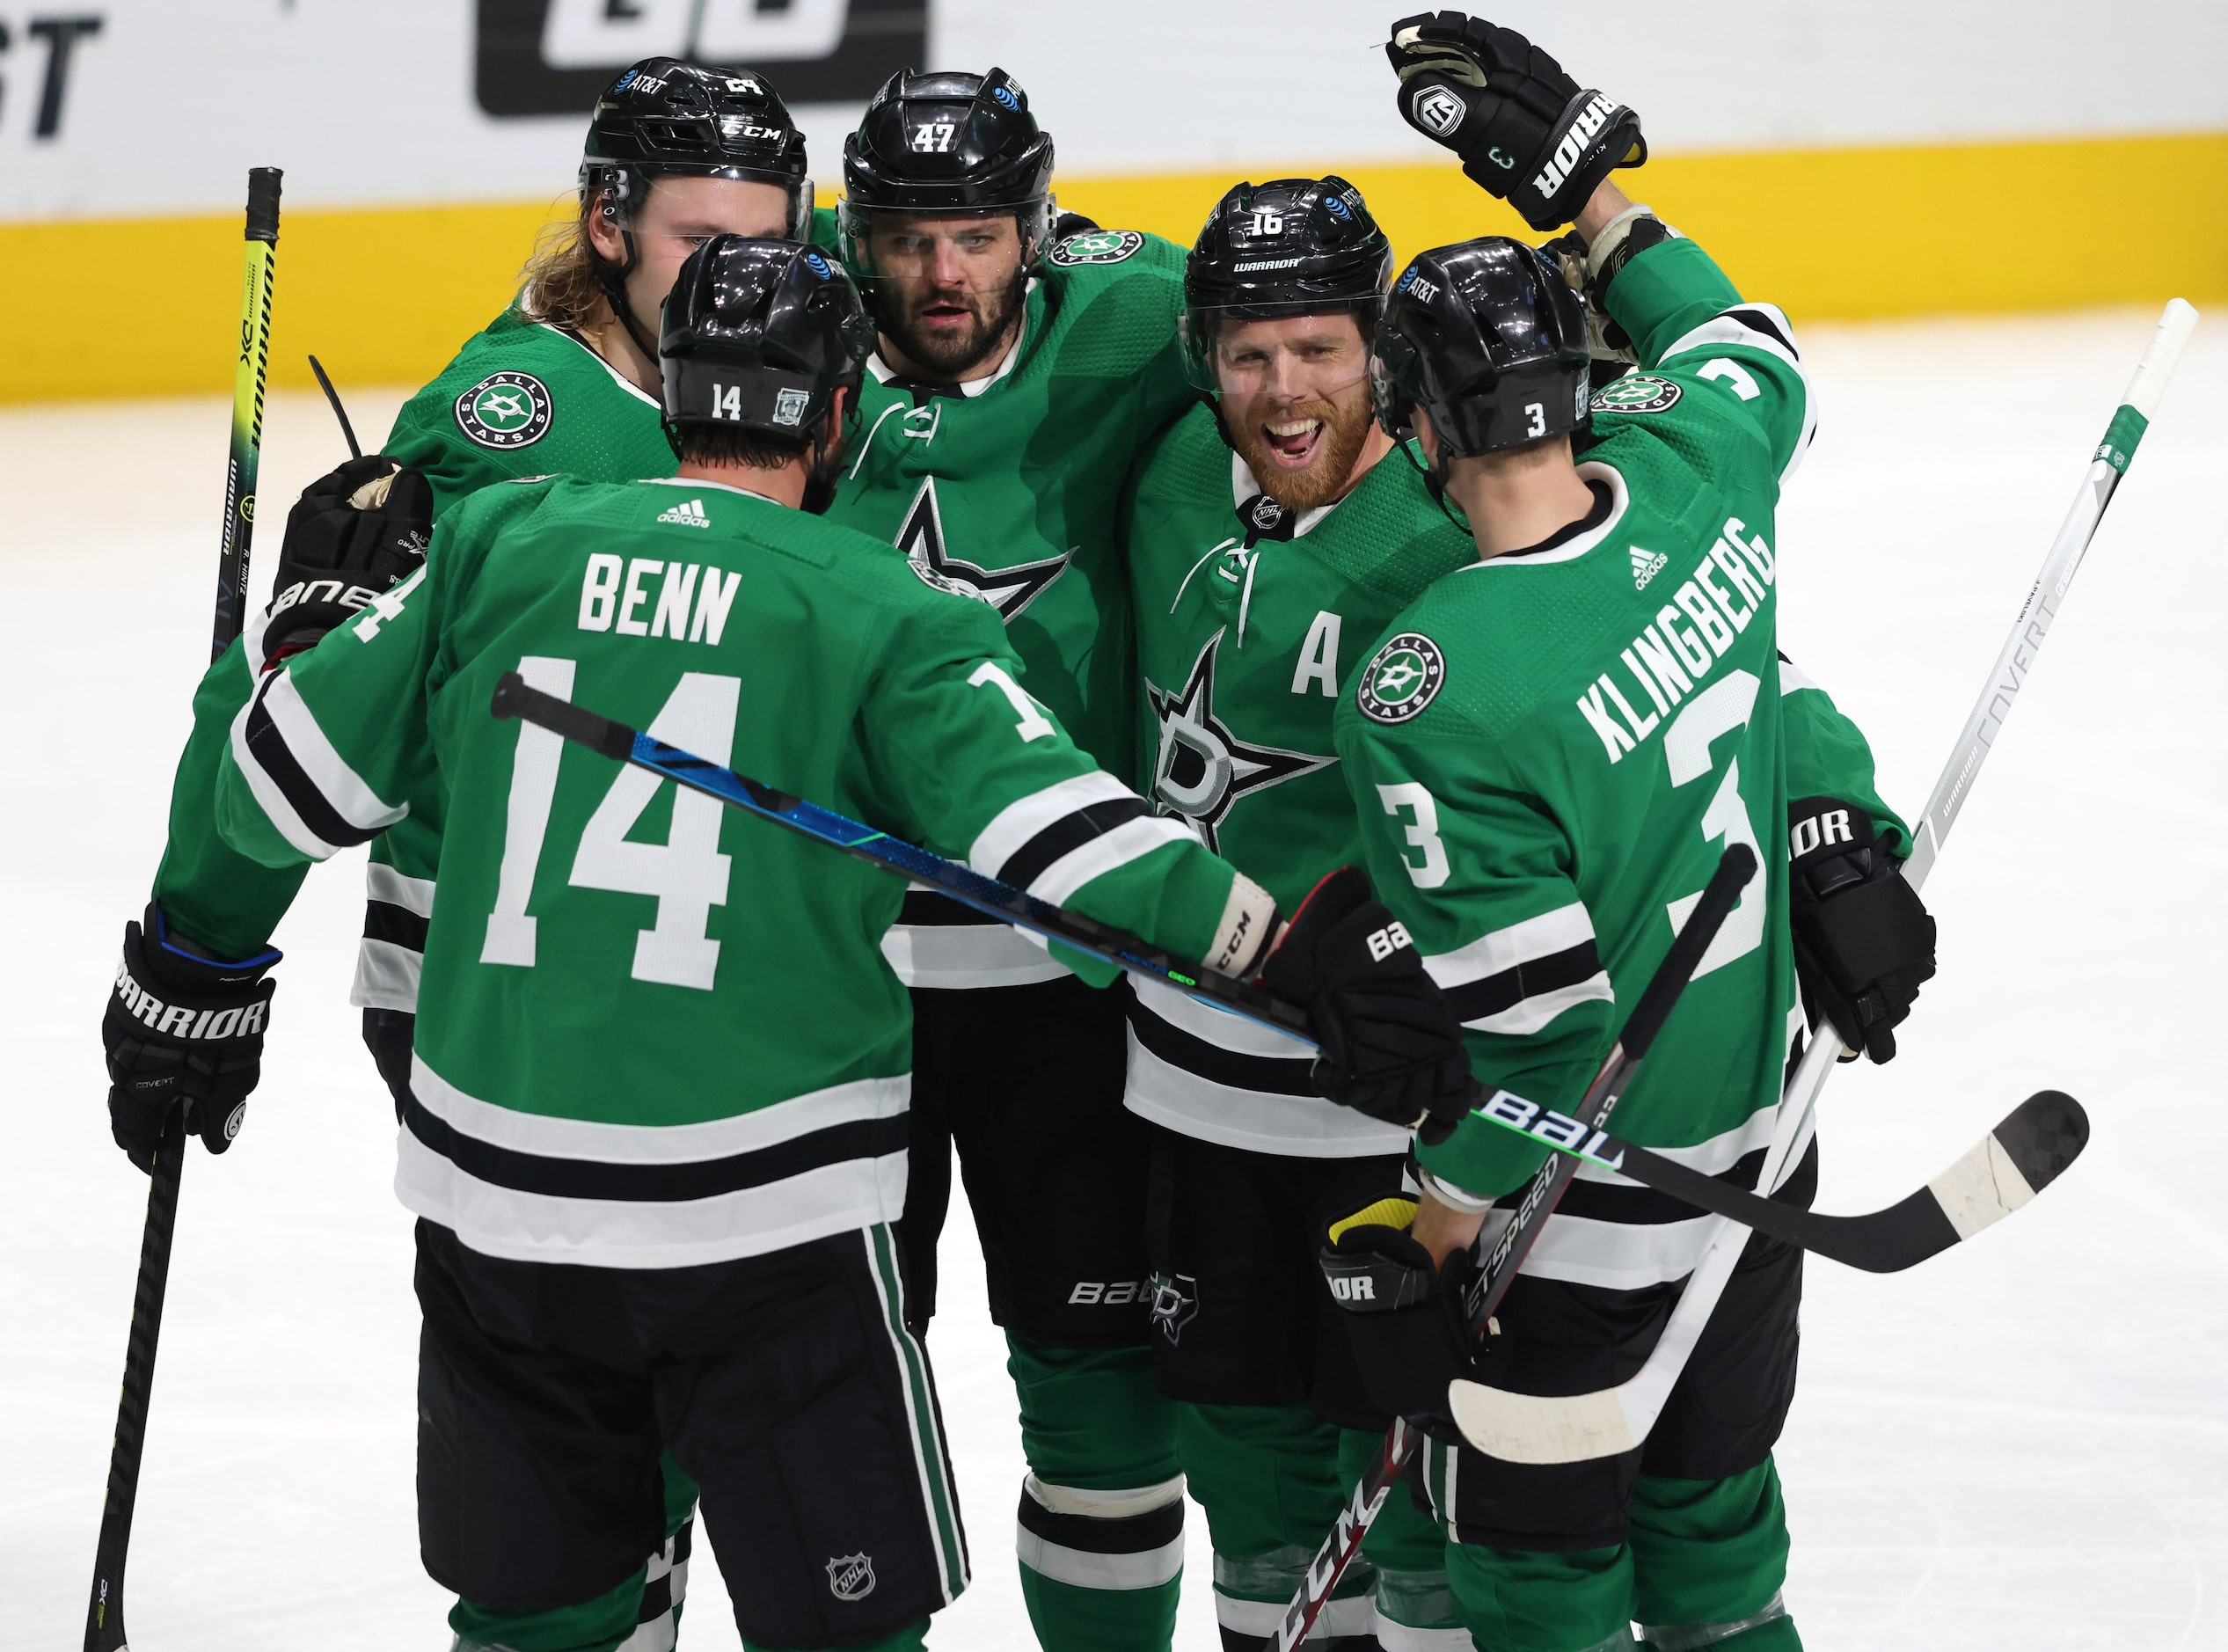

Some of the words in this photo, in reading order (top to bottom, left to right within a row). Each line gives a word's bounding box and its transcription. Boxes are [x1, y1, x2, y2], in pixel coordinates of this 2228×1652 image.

[627, 76, 668, 95] AT&T
[721, 124, 781, 141] CCM
[915, 124, 954, 153] 47
[1487, 146, 1516, 171] 3
[1252, 214, 1282, 236] 16
[1233, 259, 1299, 273] WARRIOR
[1408, 275, 1441, 305] AT&T
[476, 376, 545, 424] DALLAS
[712, 383, 741, 421] 14
[460, 403, 524, 443] STARS
[1524, 402, 1546, 437] 3
[222, 457, 237, 556] WARRIOR
[657, 513, 711, 529] adidas
[1257, 506, 1278, 519] NHL
[239, 563, 248, 596] HINTZ
[1635, 552, 1669, 591] adidas
[577, 552, 742, 646] BENN
[1290, 610, 1342, 698] A
[1371, 639, 1439, 676] DALLAS
[1577, 516, 1775, 764] KLINGBERG
[966, 661, 1057, 744] 1
[1362, 688, 1424, 717] STARS
[1942, 746, 1979, 819] WARRIOR
[478, 655, 742, 991] 14
[1375, 781, 1451, 889] 3
[1662, 669, 1768, 983] 3
[1788, 808, 1854, 863] OR
[1216, 910, 1252, 971] CCM
[1167, 969, 1196, 987] GEO
[135, 1075, 175, 1090] COVERT
[840, 1564, 865, 1591] NHL
[1277, 1478, 1370, 1652] CCM
